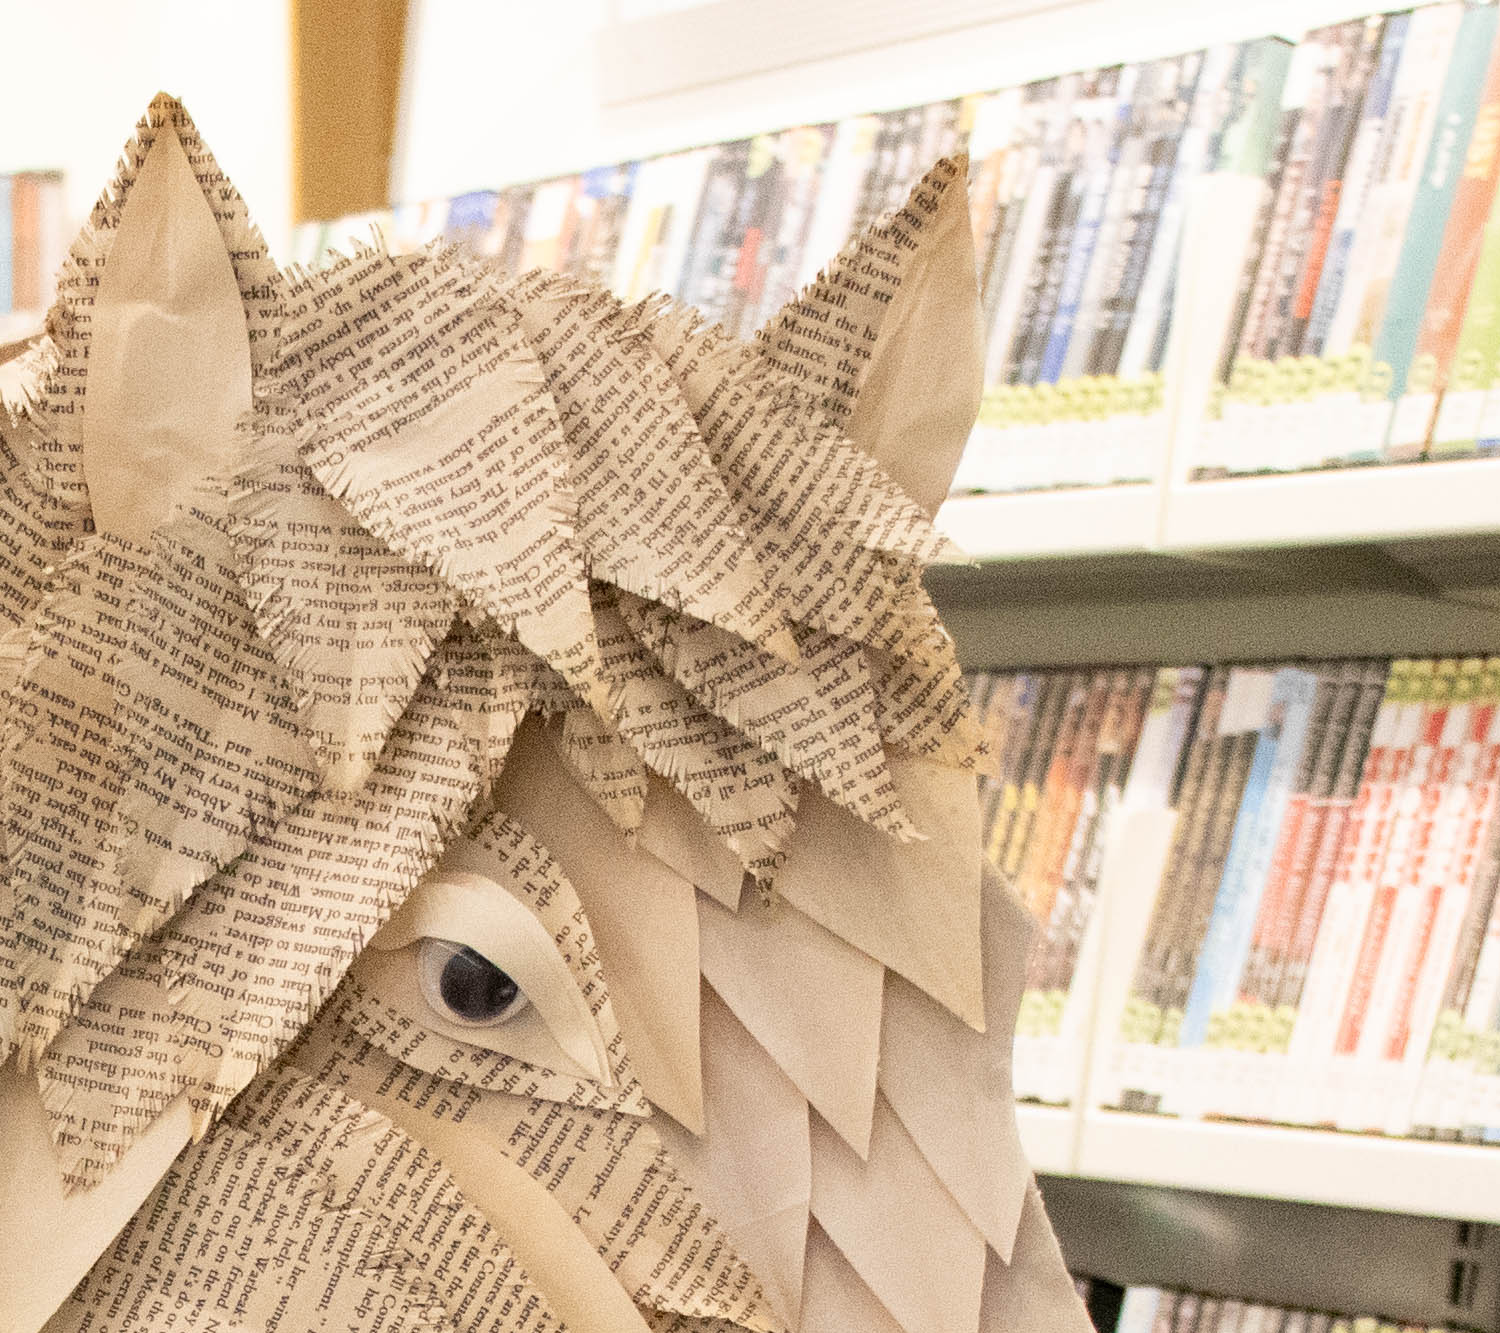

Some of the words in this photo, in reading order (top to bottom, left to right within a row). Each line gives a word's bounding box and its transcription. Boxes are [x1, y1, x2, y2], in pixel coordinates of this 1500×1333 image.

[144, 829, 173, 853] with
[178, 846, 218, 866] agree
[200, 901, 226, 915] off
[233, 909, 306, 935] swaggered
[229, 1256, 271, 1328] Warbeak's
